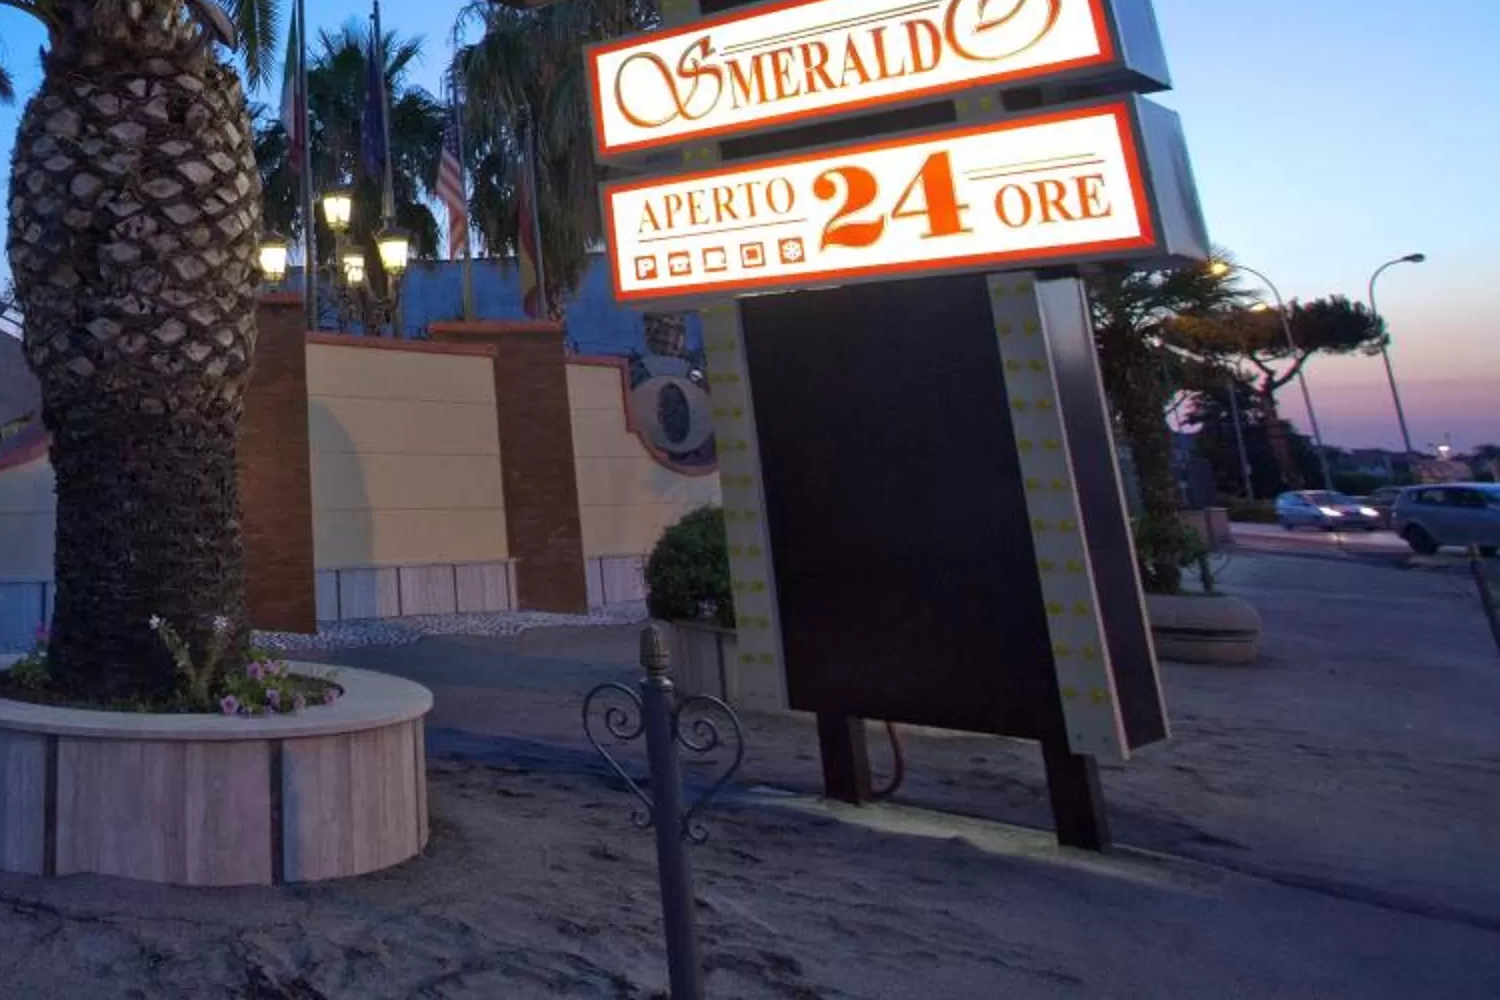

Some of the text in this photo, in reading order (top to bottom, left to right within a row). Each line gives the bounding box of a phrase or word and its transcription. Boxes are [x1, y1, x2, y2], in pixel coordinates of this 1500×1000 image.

[638, 151, 1113, 252] APERTO 24 ORE
